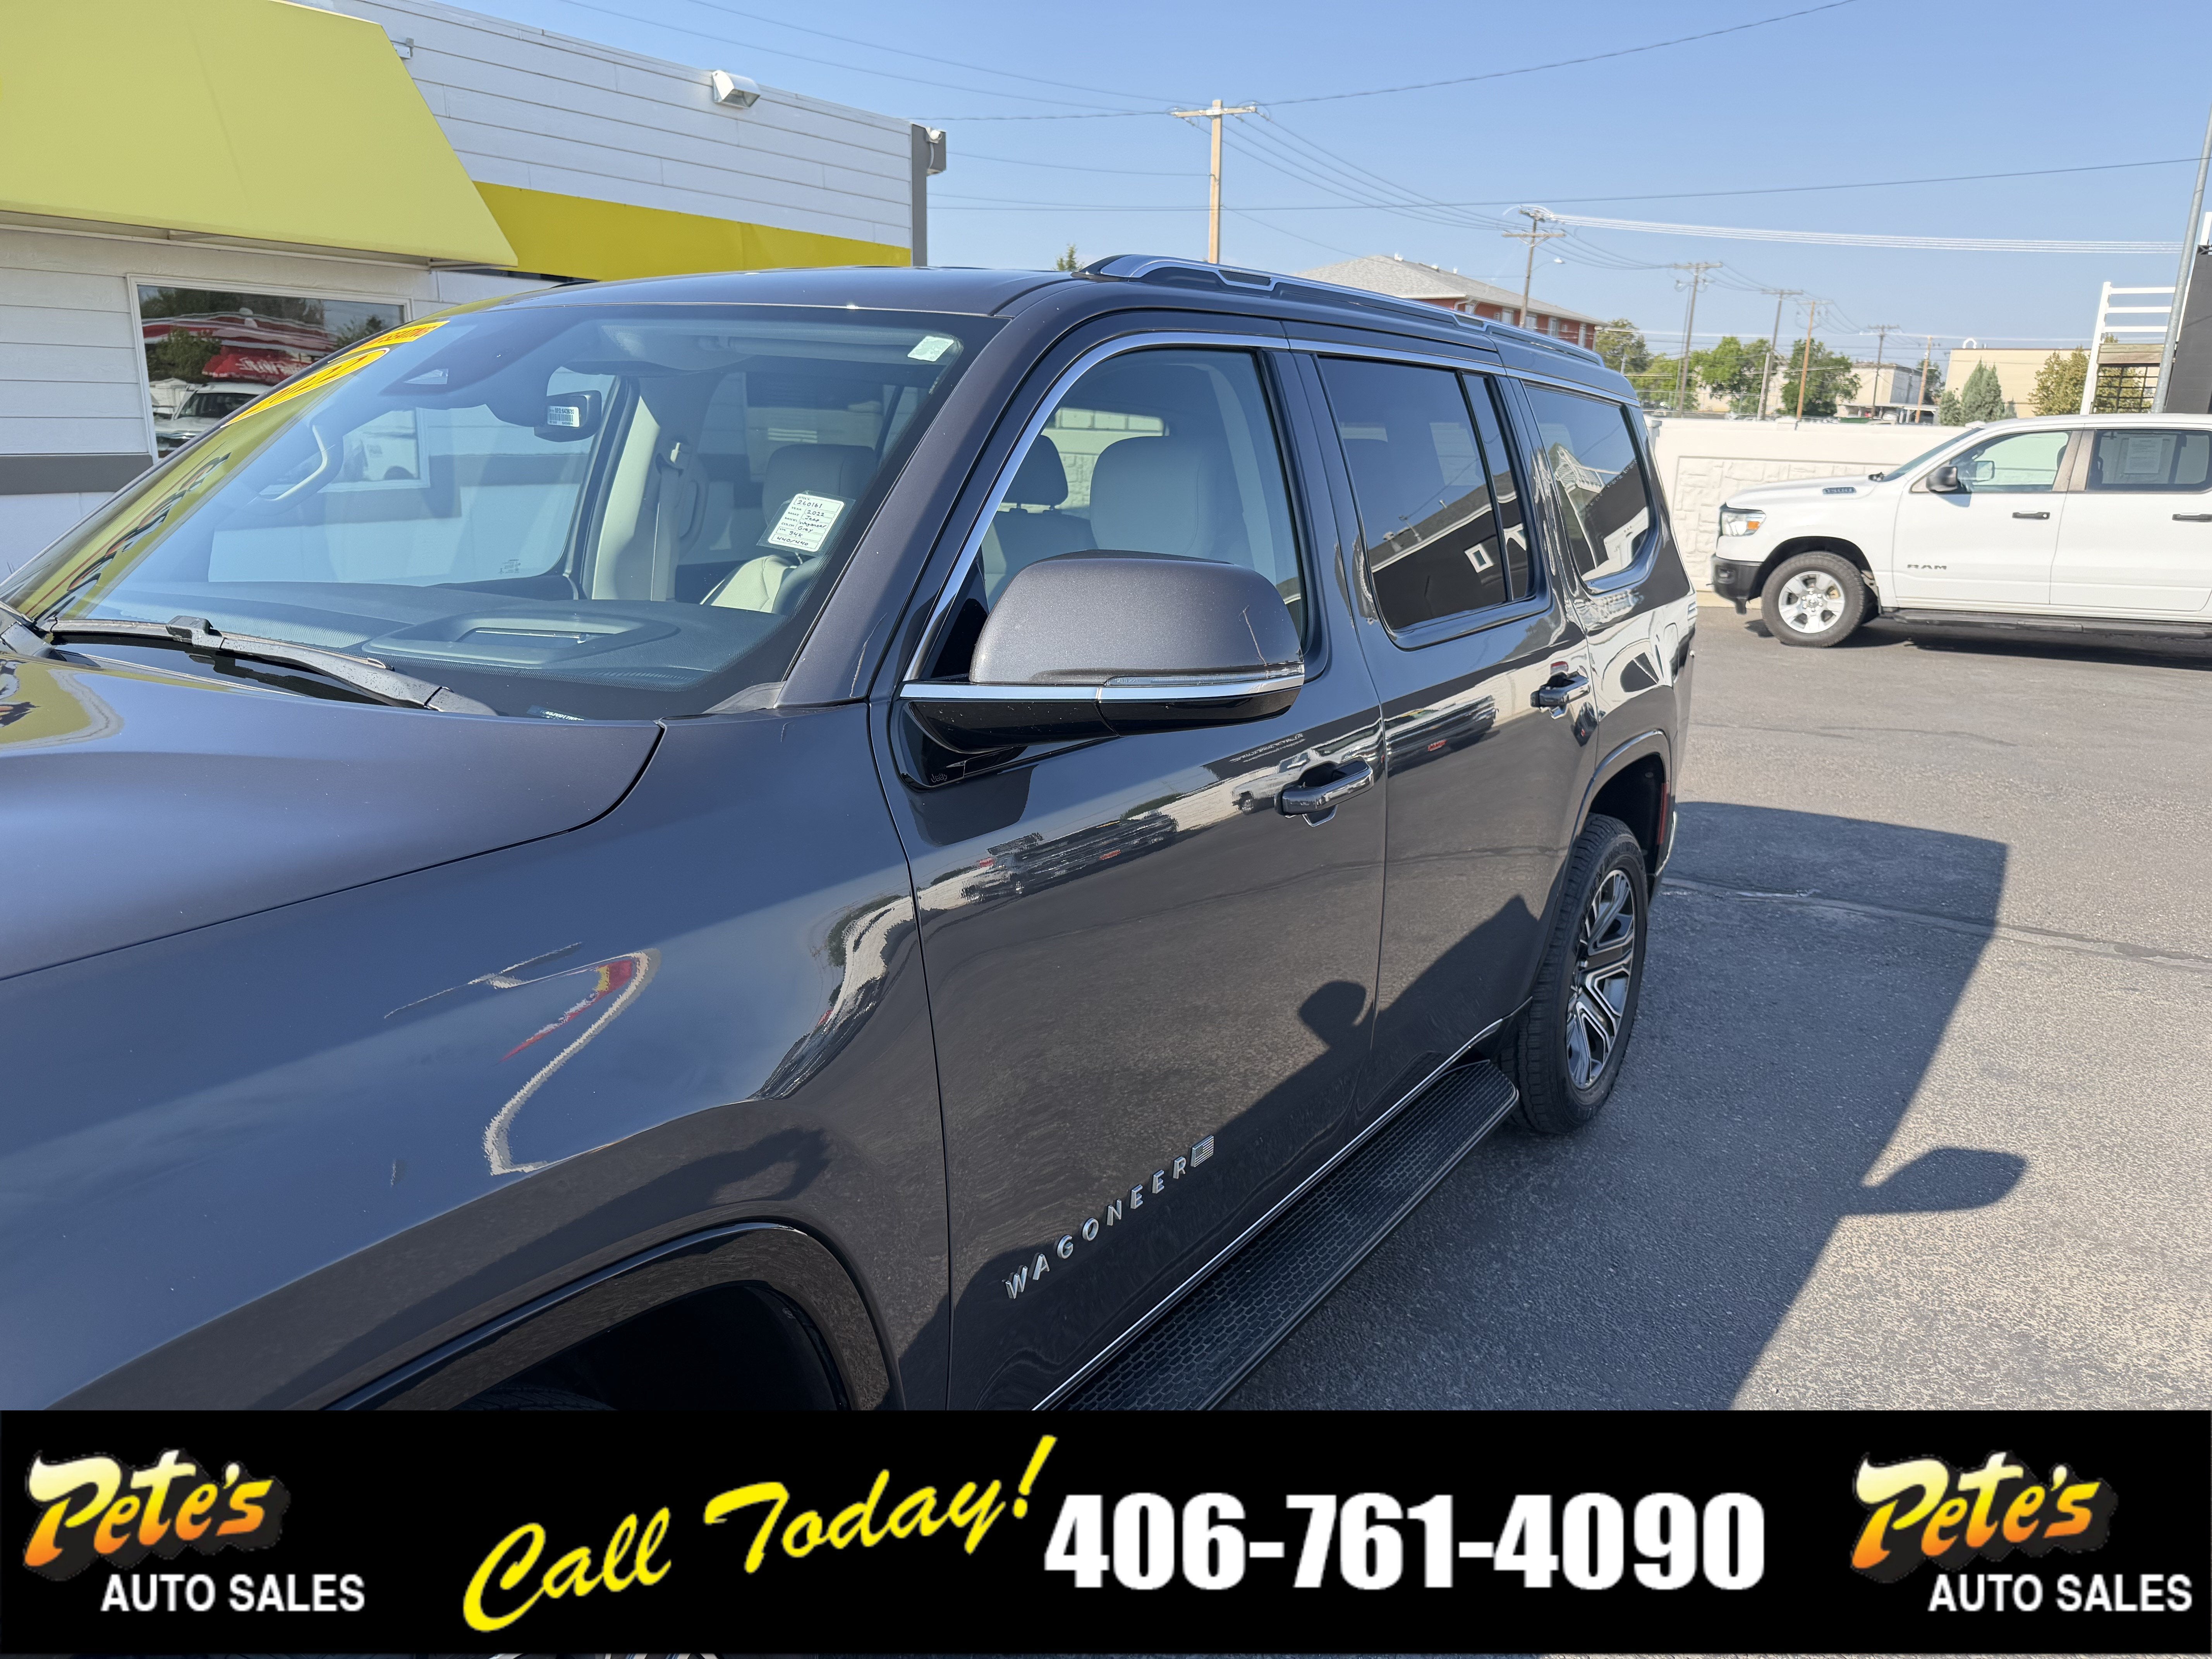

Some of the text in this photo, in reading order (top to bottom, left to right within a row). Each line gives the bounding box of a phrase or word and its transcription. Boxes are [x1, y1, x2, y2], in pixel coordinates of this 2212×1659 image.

[797, 500, 823, 508] 260161
[777, 536, 809, 546] 440/440
[931, 773, 948, 783] Jeep
[1005, 1156, 1187, 1300] WAGONEER
